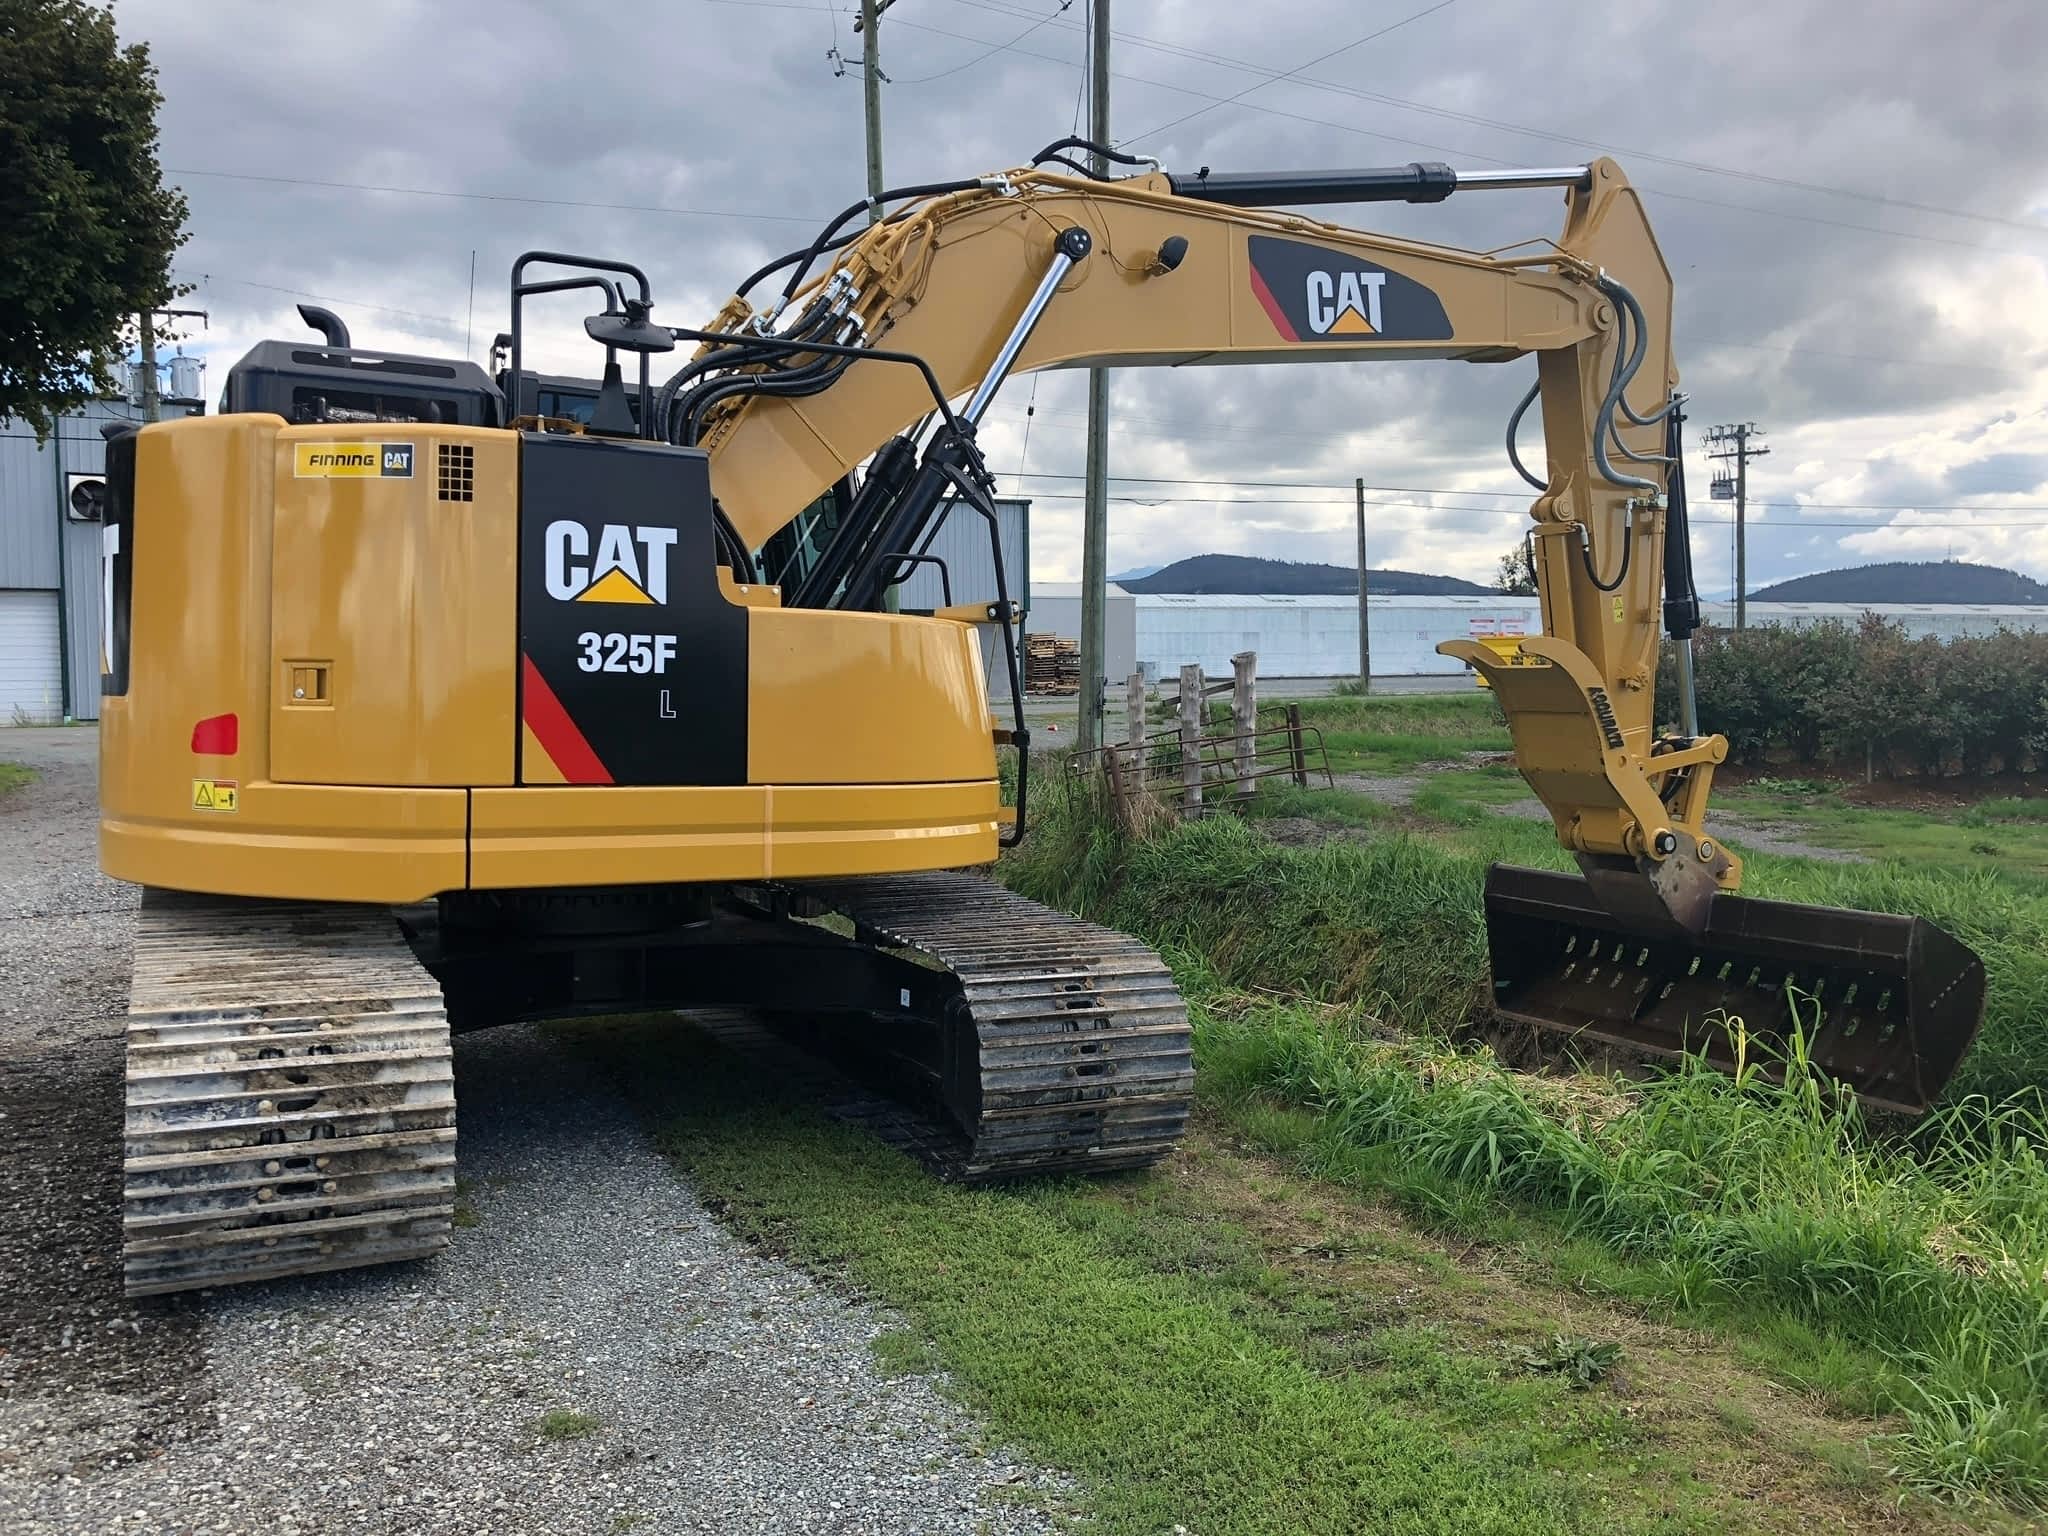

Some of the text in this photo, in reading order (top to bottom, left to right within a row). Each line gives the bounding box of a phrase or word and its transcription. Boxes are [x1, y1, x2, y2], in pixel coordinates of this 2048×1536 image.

[1306, 270, 1386, 334] CAT
[309, 452, 410, 469] FINNING CAT
[545, 519, 678, 605] CAT
[577, 631, 677, 674] 325F
[660, 689, 677, 719] L
[1588, 687, 1624, 750] ACCURATE
